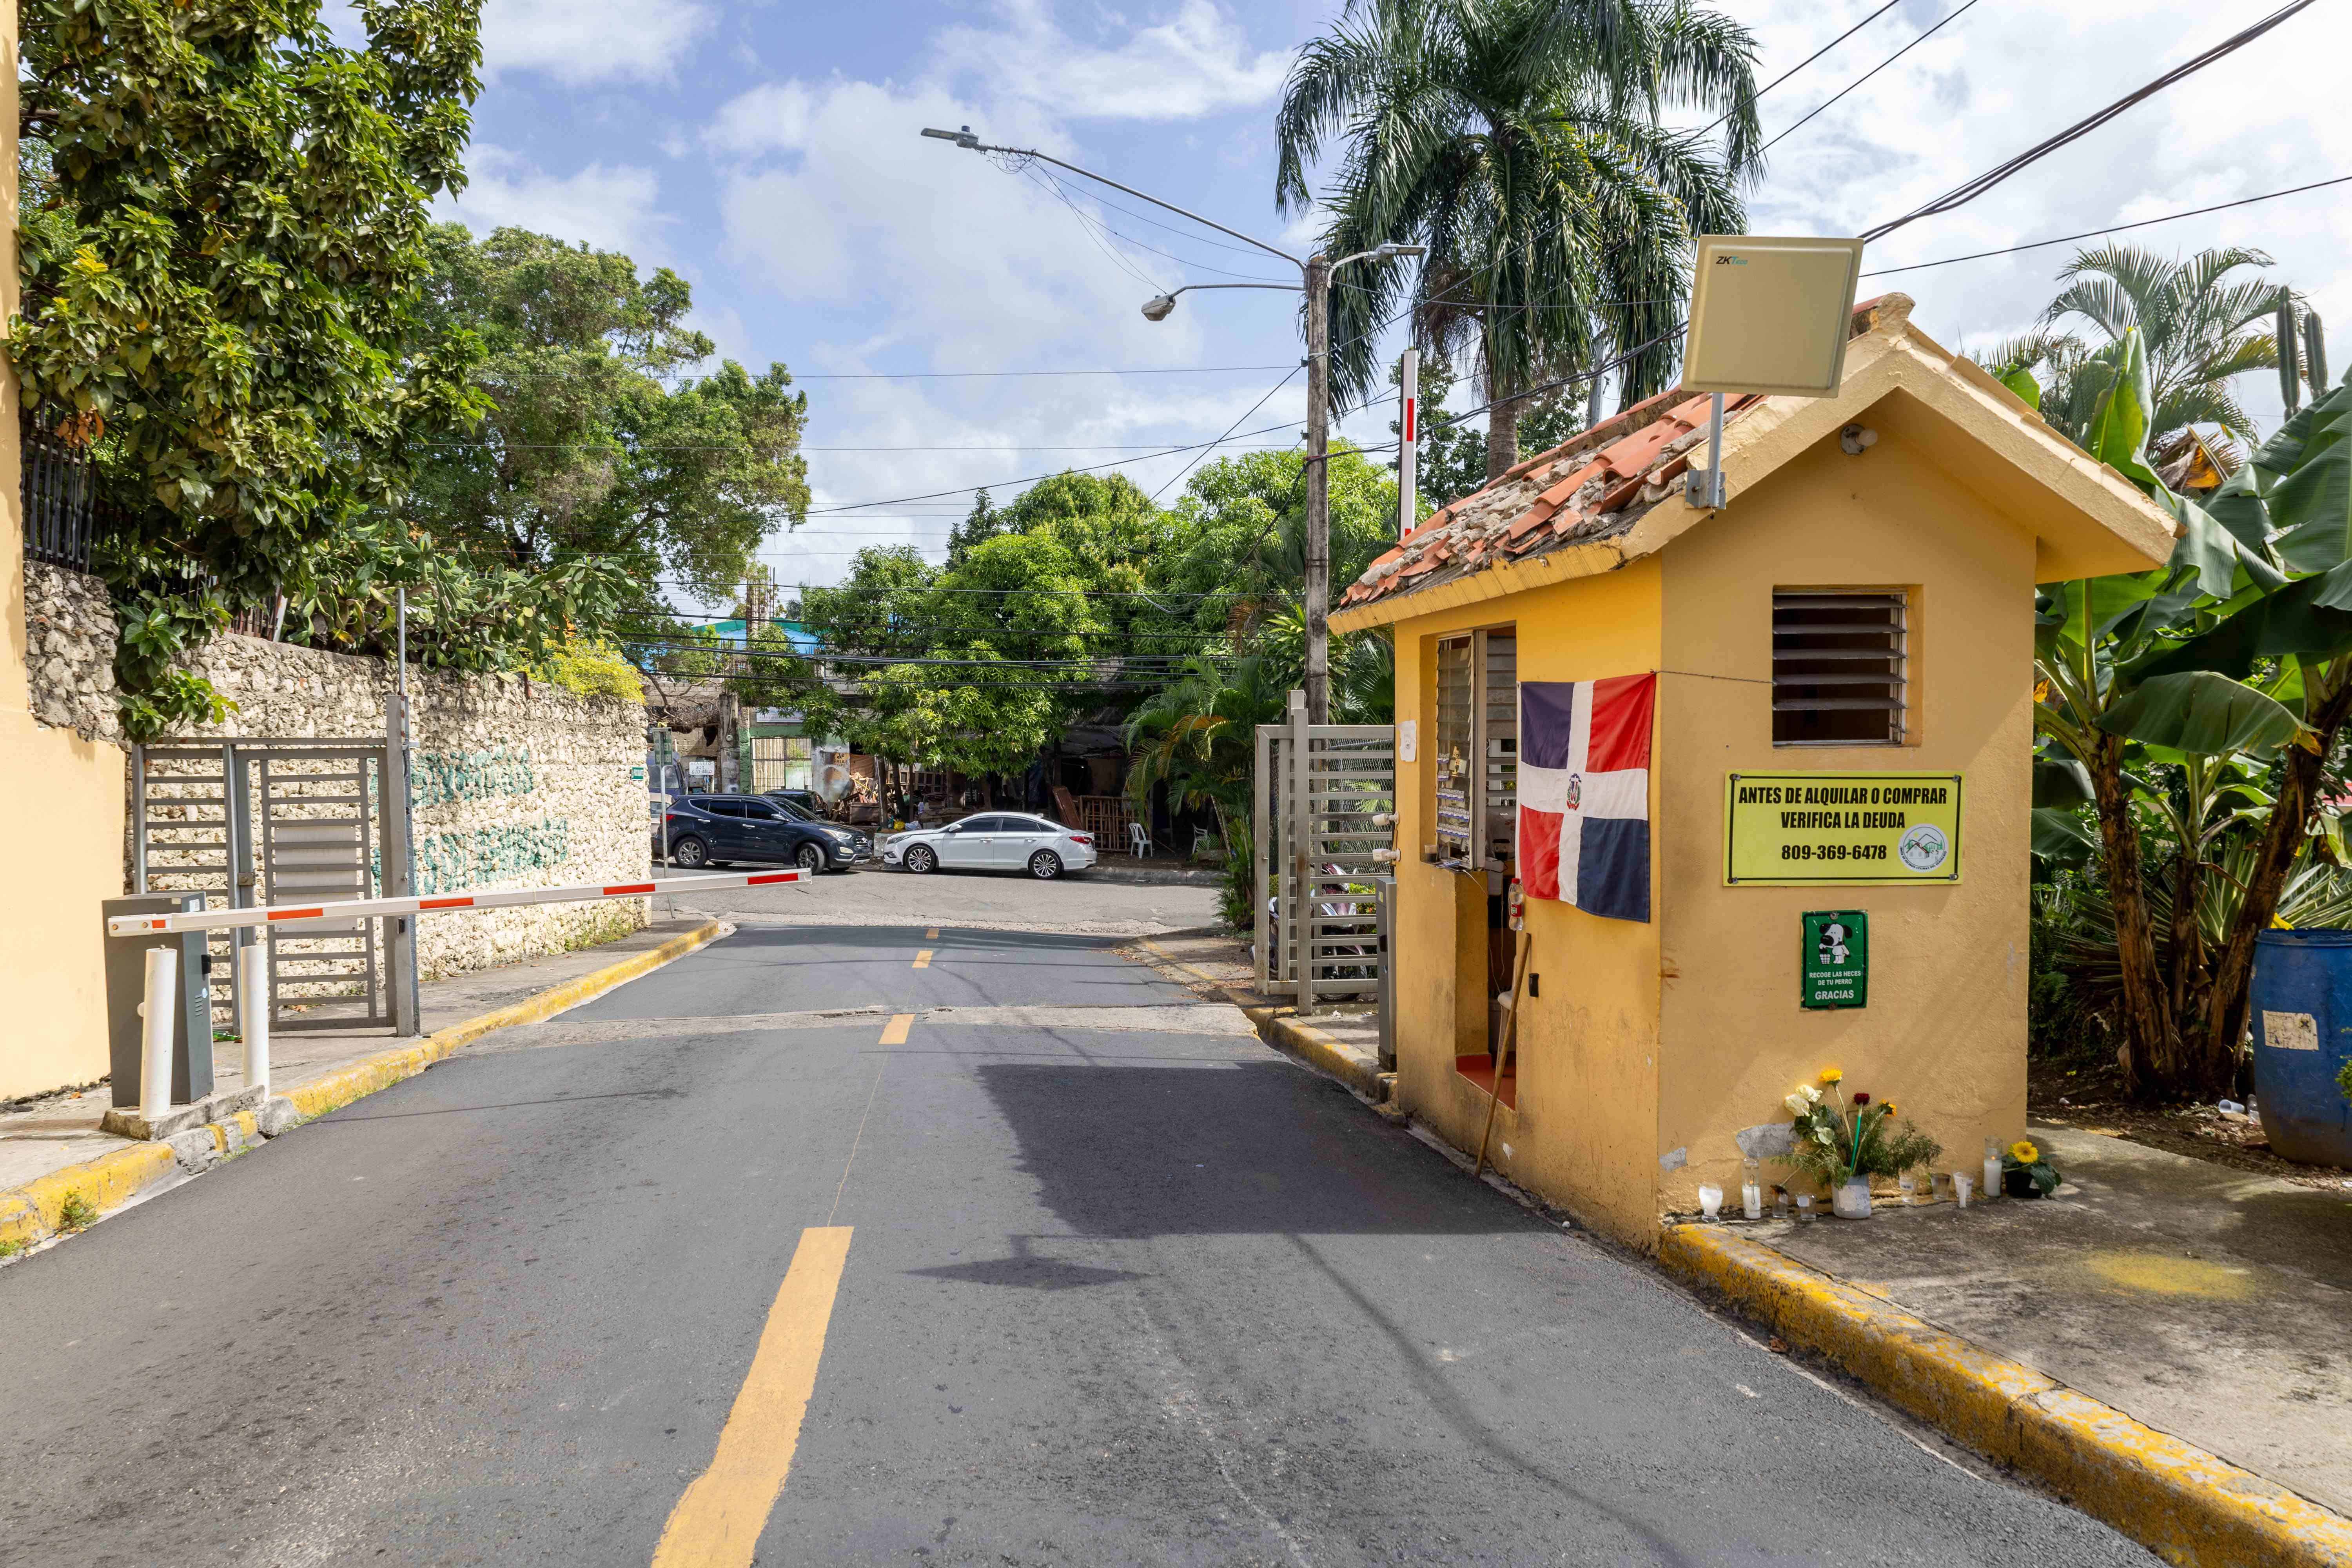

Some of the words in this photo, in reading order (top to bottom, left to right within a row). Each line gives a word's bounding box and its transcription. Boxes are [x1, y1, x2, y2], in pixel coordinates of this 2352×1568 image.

[1738, 787, 1782, 804] ANTES
[1785, 787, 1802, 804] DE
[1804, 787, 1868, 806] ALQUILAR
[1871, 788, 1880, 804] O
[1882, 788, 1947, 804] COMPRAR
[1781, 812, 1842, 829] VERIFICA
[1844, 812, 1860, 828] LA
[1862, 812, 1906, 828] DEUDA
[1782, 845, 1887, 860] 809-369-6478
[1815, 990, 1854, 1000] GRACIAS
